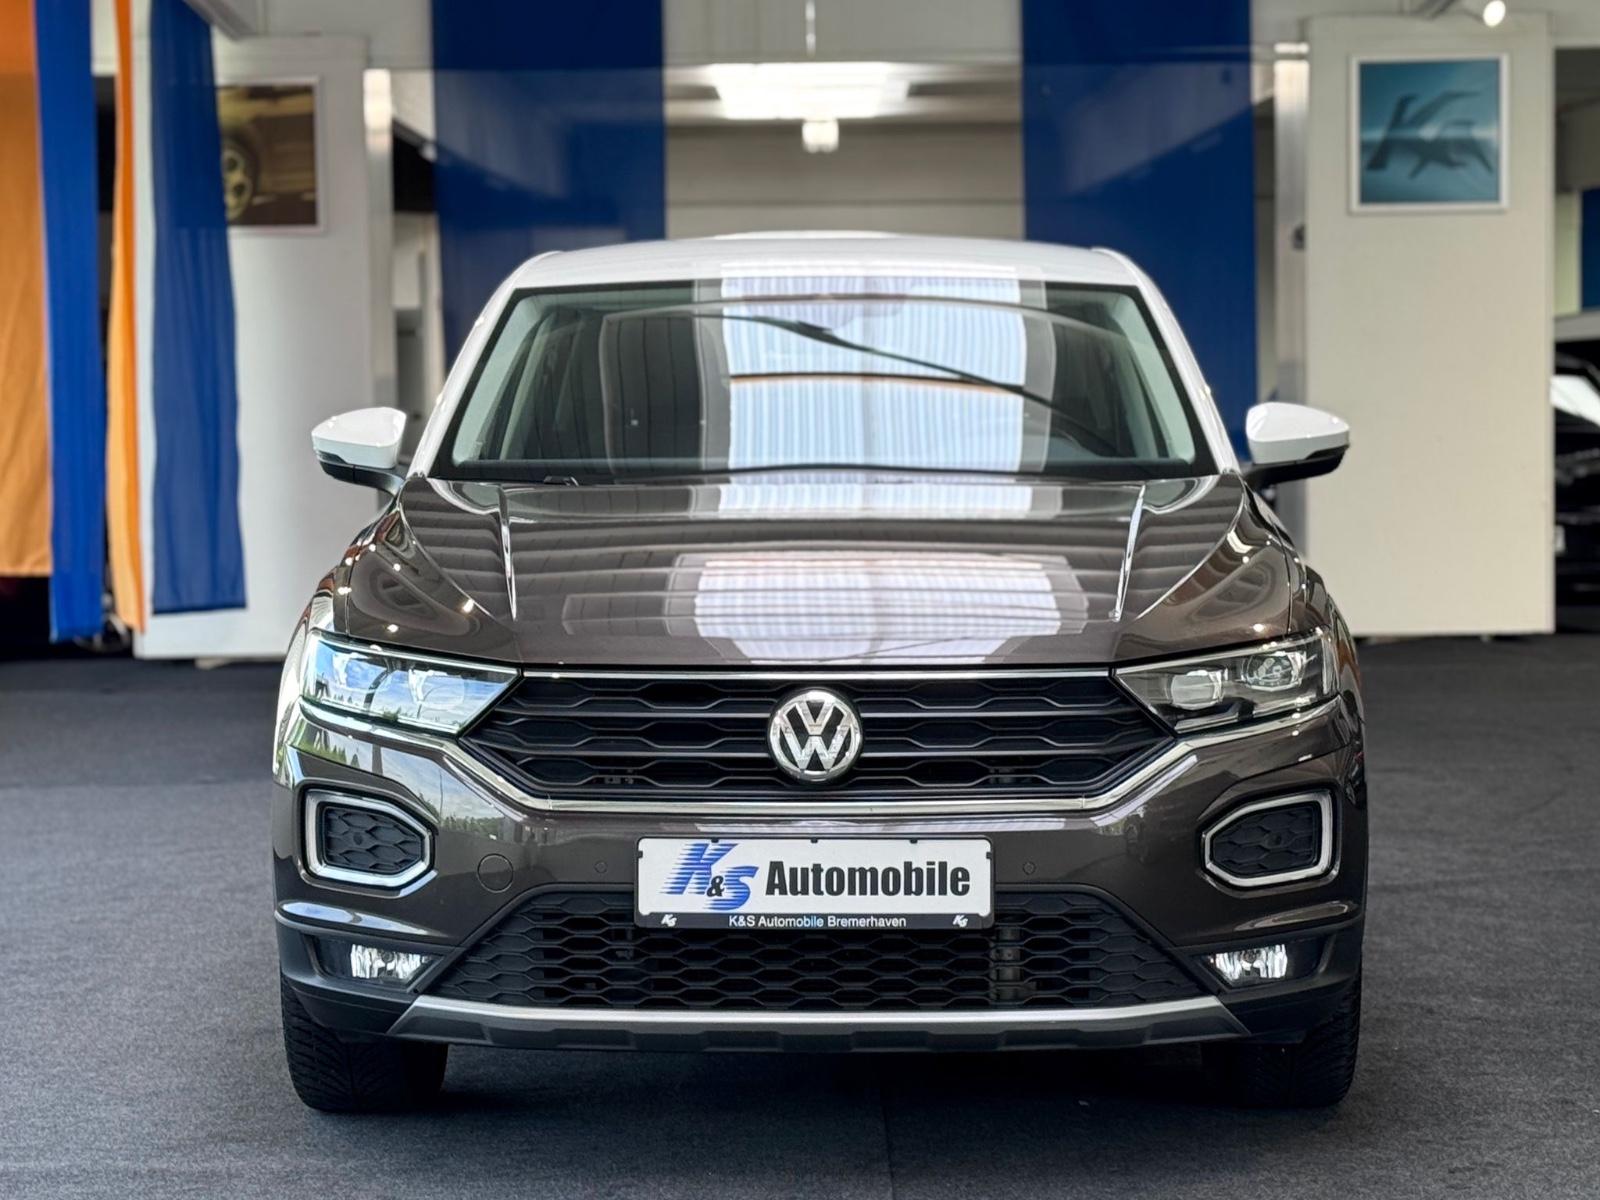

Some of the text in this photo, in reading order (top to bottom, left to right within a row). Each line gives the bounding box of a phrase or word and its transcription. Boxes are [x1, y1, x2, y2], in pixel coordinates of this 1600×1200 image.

[779, 699, 851, 771] VW
[660, 842, 970, 911] K&S Automobile
[728, 914, 907, 928] K&S Automobile Bremerhaven
